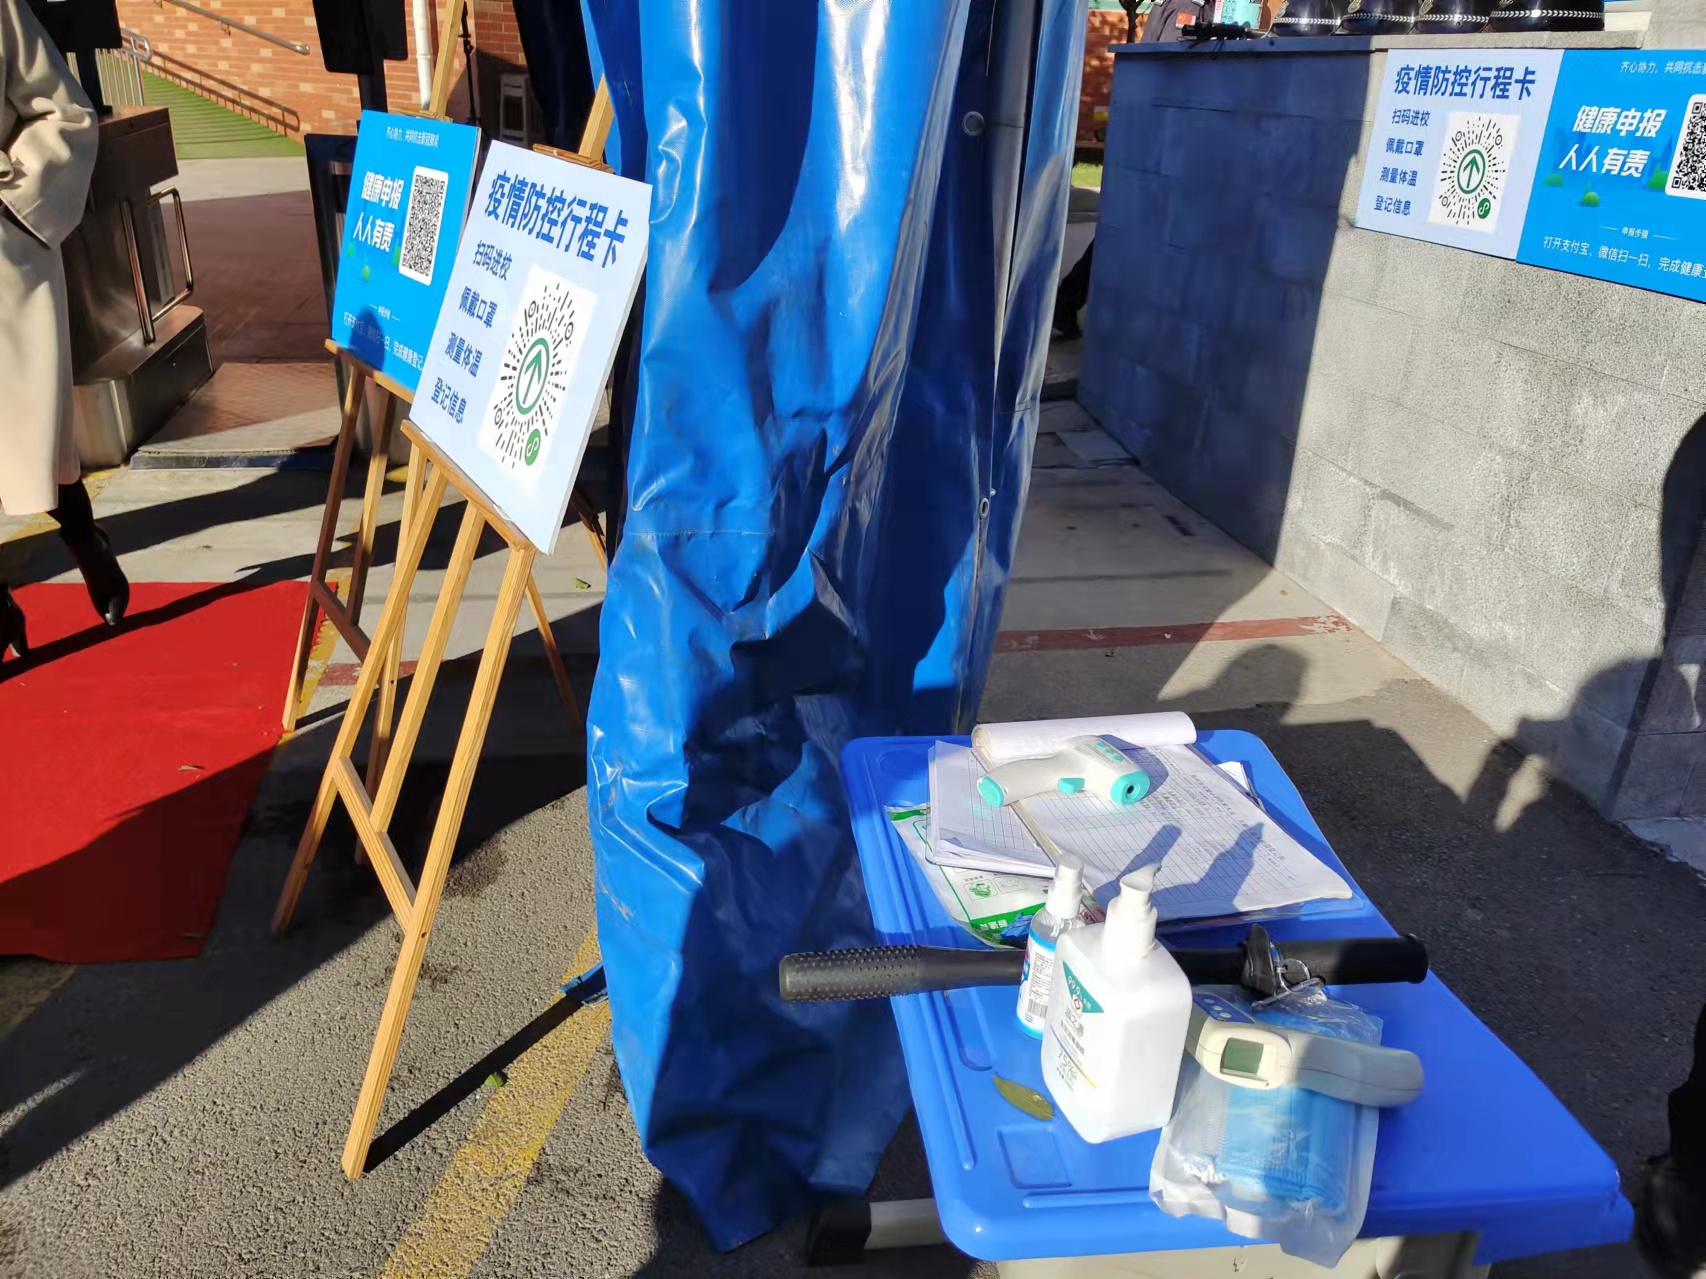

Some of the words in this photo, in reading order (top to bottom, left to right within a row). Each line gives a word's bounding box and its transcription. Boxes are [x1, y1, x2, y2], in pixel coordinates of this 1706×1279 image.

[1394, 64, 1536, 100] 疫情防控行程卡
[1391, 108, 1431, 128] 扫码进校
[1572, 105, 1667, 138] 健康申报
[1386, 138, 1424, 157] 佩戴口罩
[1559, 144, 1651, 178] 人人有责
[361, 171, 404, 210] 健康申报
[1379, 167, 1418, 187] 测量体温
[484, 169, 629, 269] 疫情防控行程卡
[1373, 195, 1411, 216] 登记信息
[354, 211, 396, 253] 人人有责
[473, 240, 513, 281] 扫码进校
[459, 286, 498, 329] 佩戴口罩
[444, 331, 482, 378] 测量体温
[430, 376, 467, 424] 登记信息
